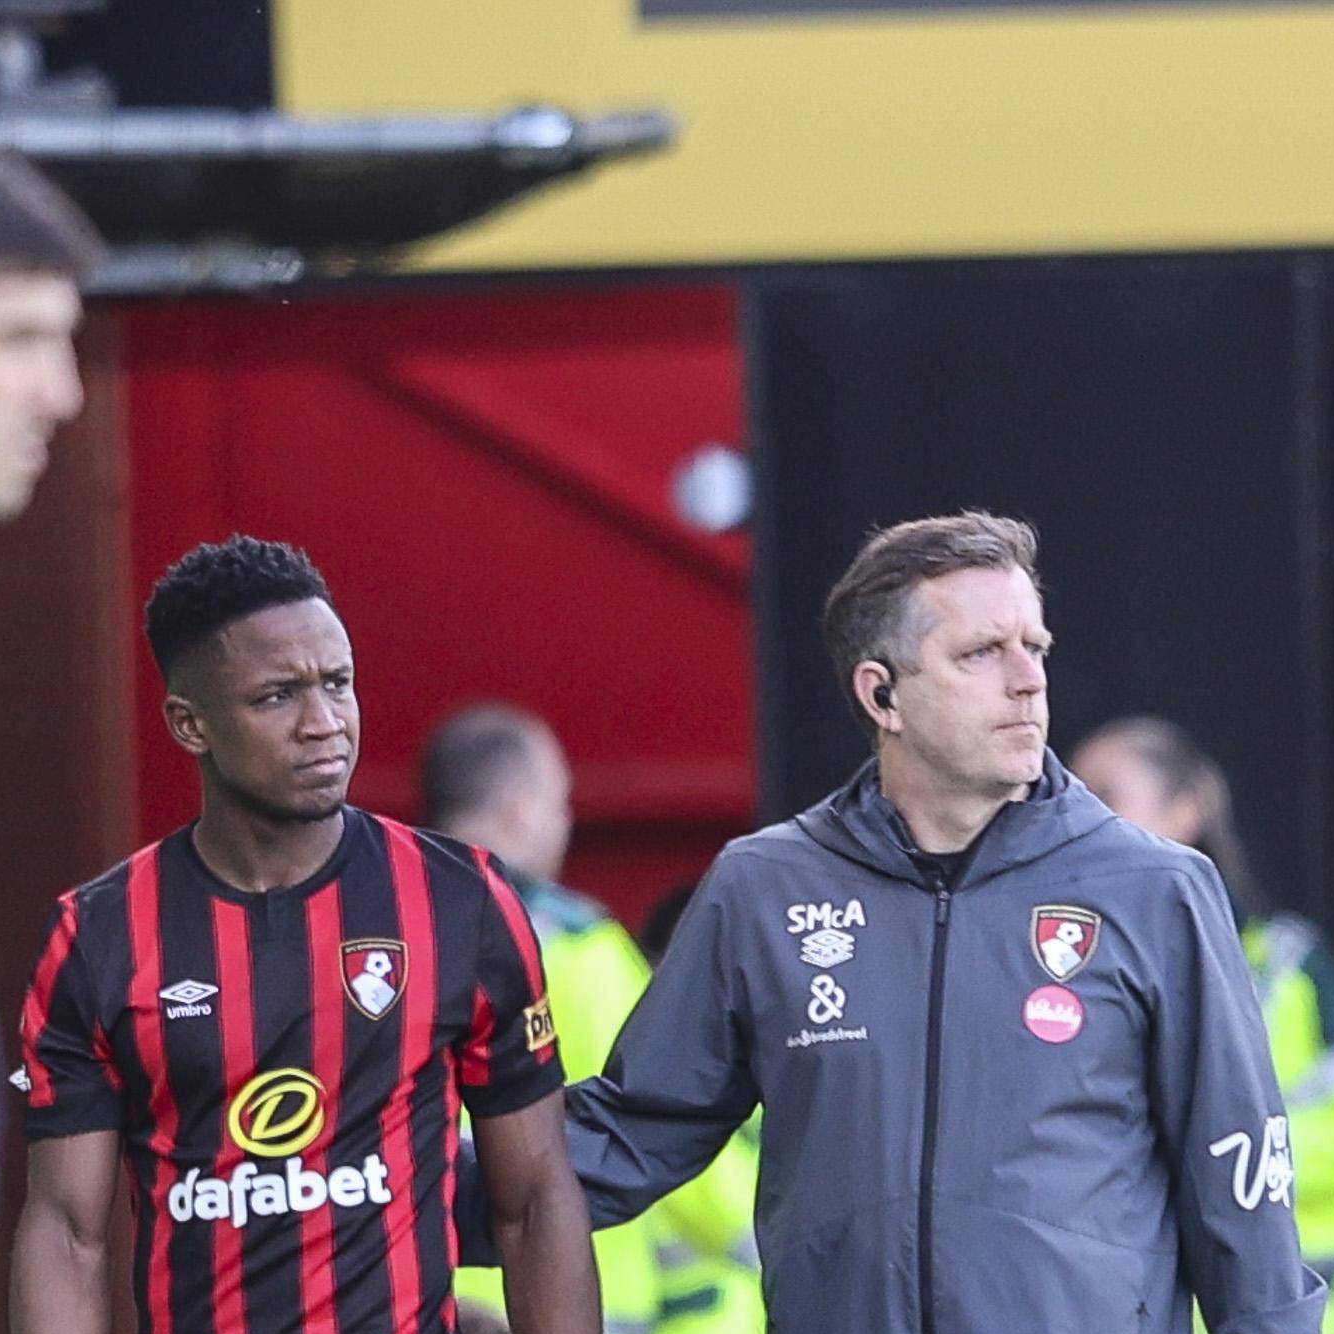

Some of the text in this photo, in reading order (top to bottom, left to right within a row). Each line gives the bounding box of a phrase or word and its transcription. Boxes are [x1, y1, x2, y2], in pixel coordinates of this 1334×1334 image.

[787, 899, 866, 934] SMcA
[167, 1004, 212, 1019] umbro
[168, 1153, 392, 1228] dafabet
